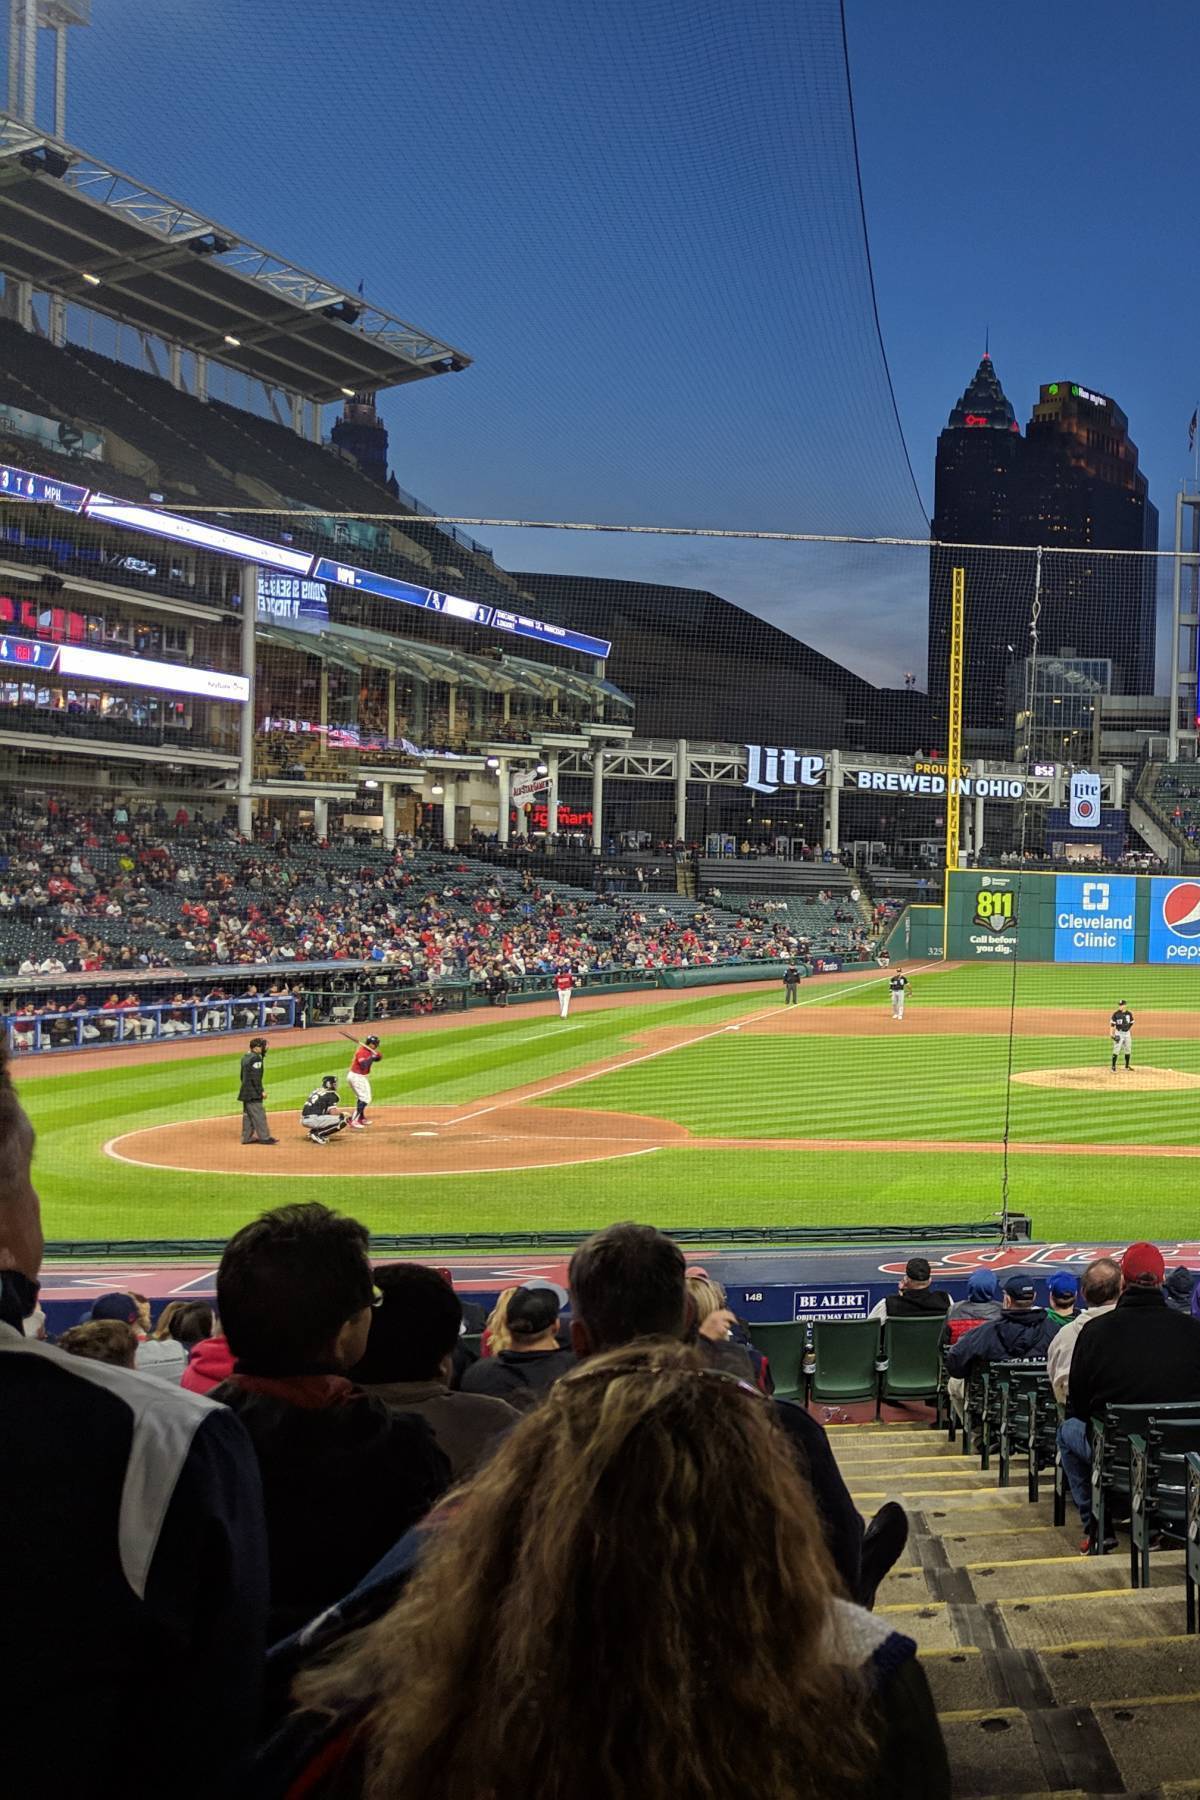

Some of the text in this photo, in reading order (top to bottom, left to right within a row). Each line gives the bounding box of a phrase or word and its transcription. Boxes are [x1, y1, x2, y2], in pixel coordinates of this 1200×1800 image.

[742, 744, 824, 793] Lite
[915, 763, 969, 776] PROUDLY
[858, 771, 1023, 798] BREWED IN OHIO
[1073, 783, 1098, 799] Lite
[977, 891, 1013, 918] 811
[1058, 914, 1133, 929] Cleveland
[970, 935, 988, 943] Call
[1073, 932, 1116, 947] Clinic
[928, 947, 943, 955] 325
[995, 945, 1012, 954] dig.
[744, 1293, 763, 1302] 148
[799, 1294, 865, 1308] BE ALERT
[843, 1312, 867, 1320] ENTER
